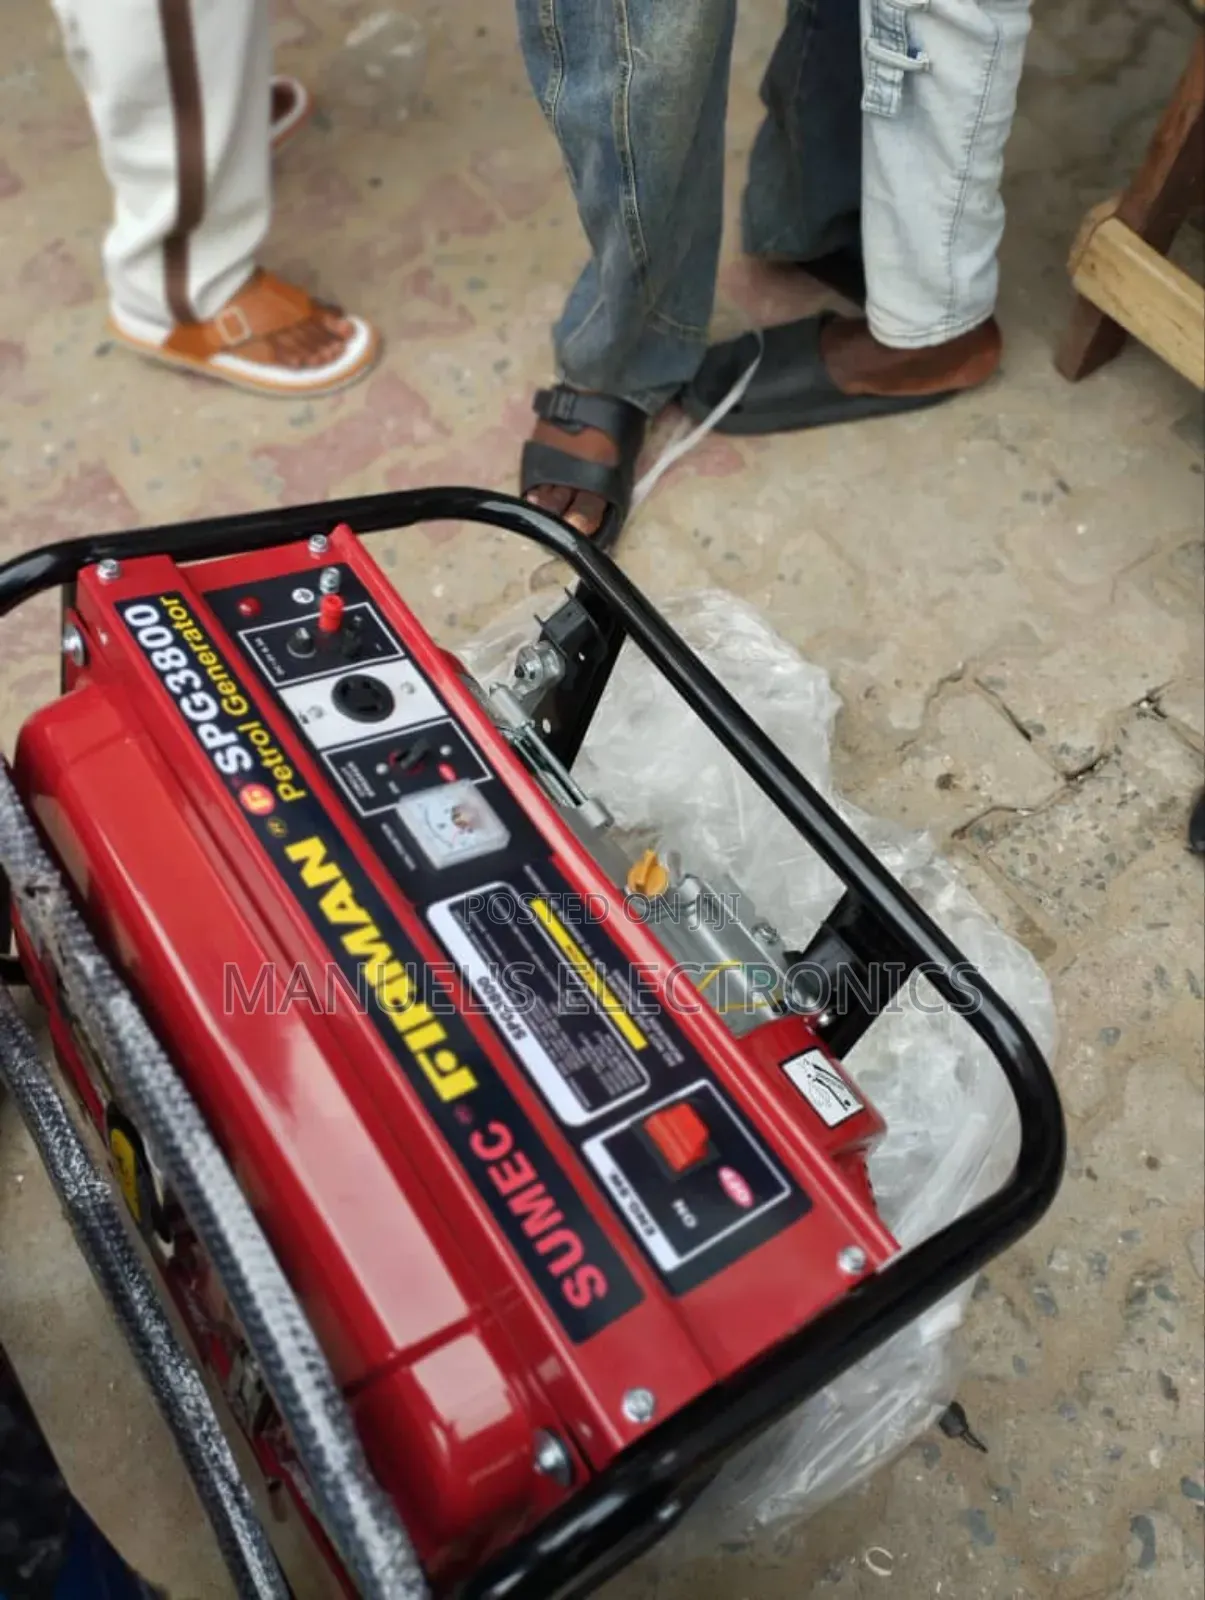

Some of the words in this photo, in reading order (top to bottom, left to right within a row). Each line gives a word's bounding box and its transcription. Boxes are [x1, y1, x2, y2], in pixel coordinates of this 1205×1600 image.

[124, 604, 252, 774] SPG3800
[159, 595, 248, 696] Generator
[237, 721, 306, 802] Petrol
[470, 1120, 606, 1309] SUMEC
